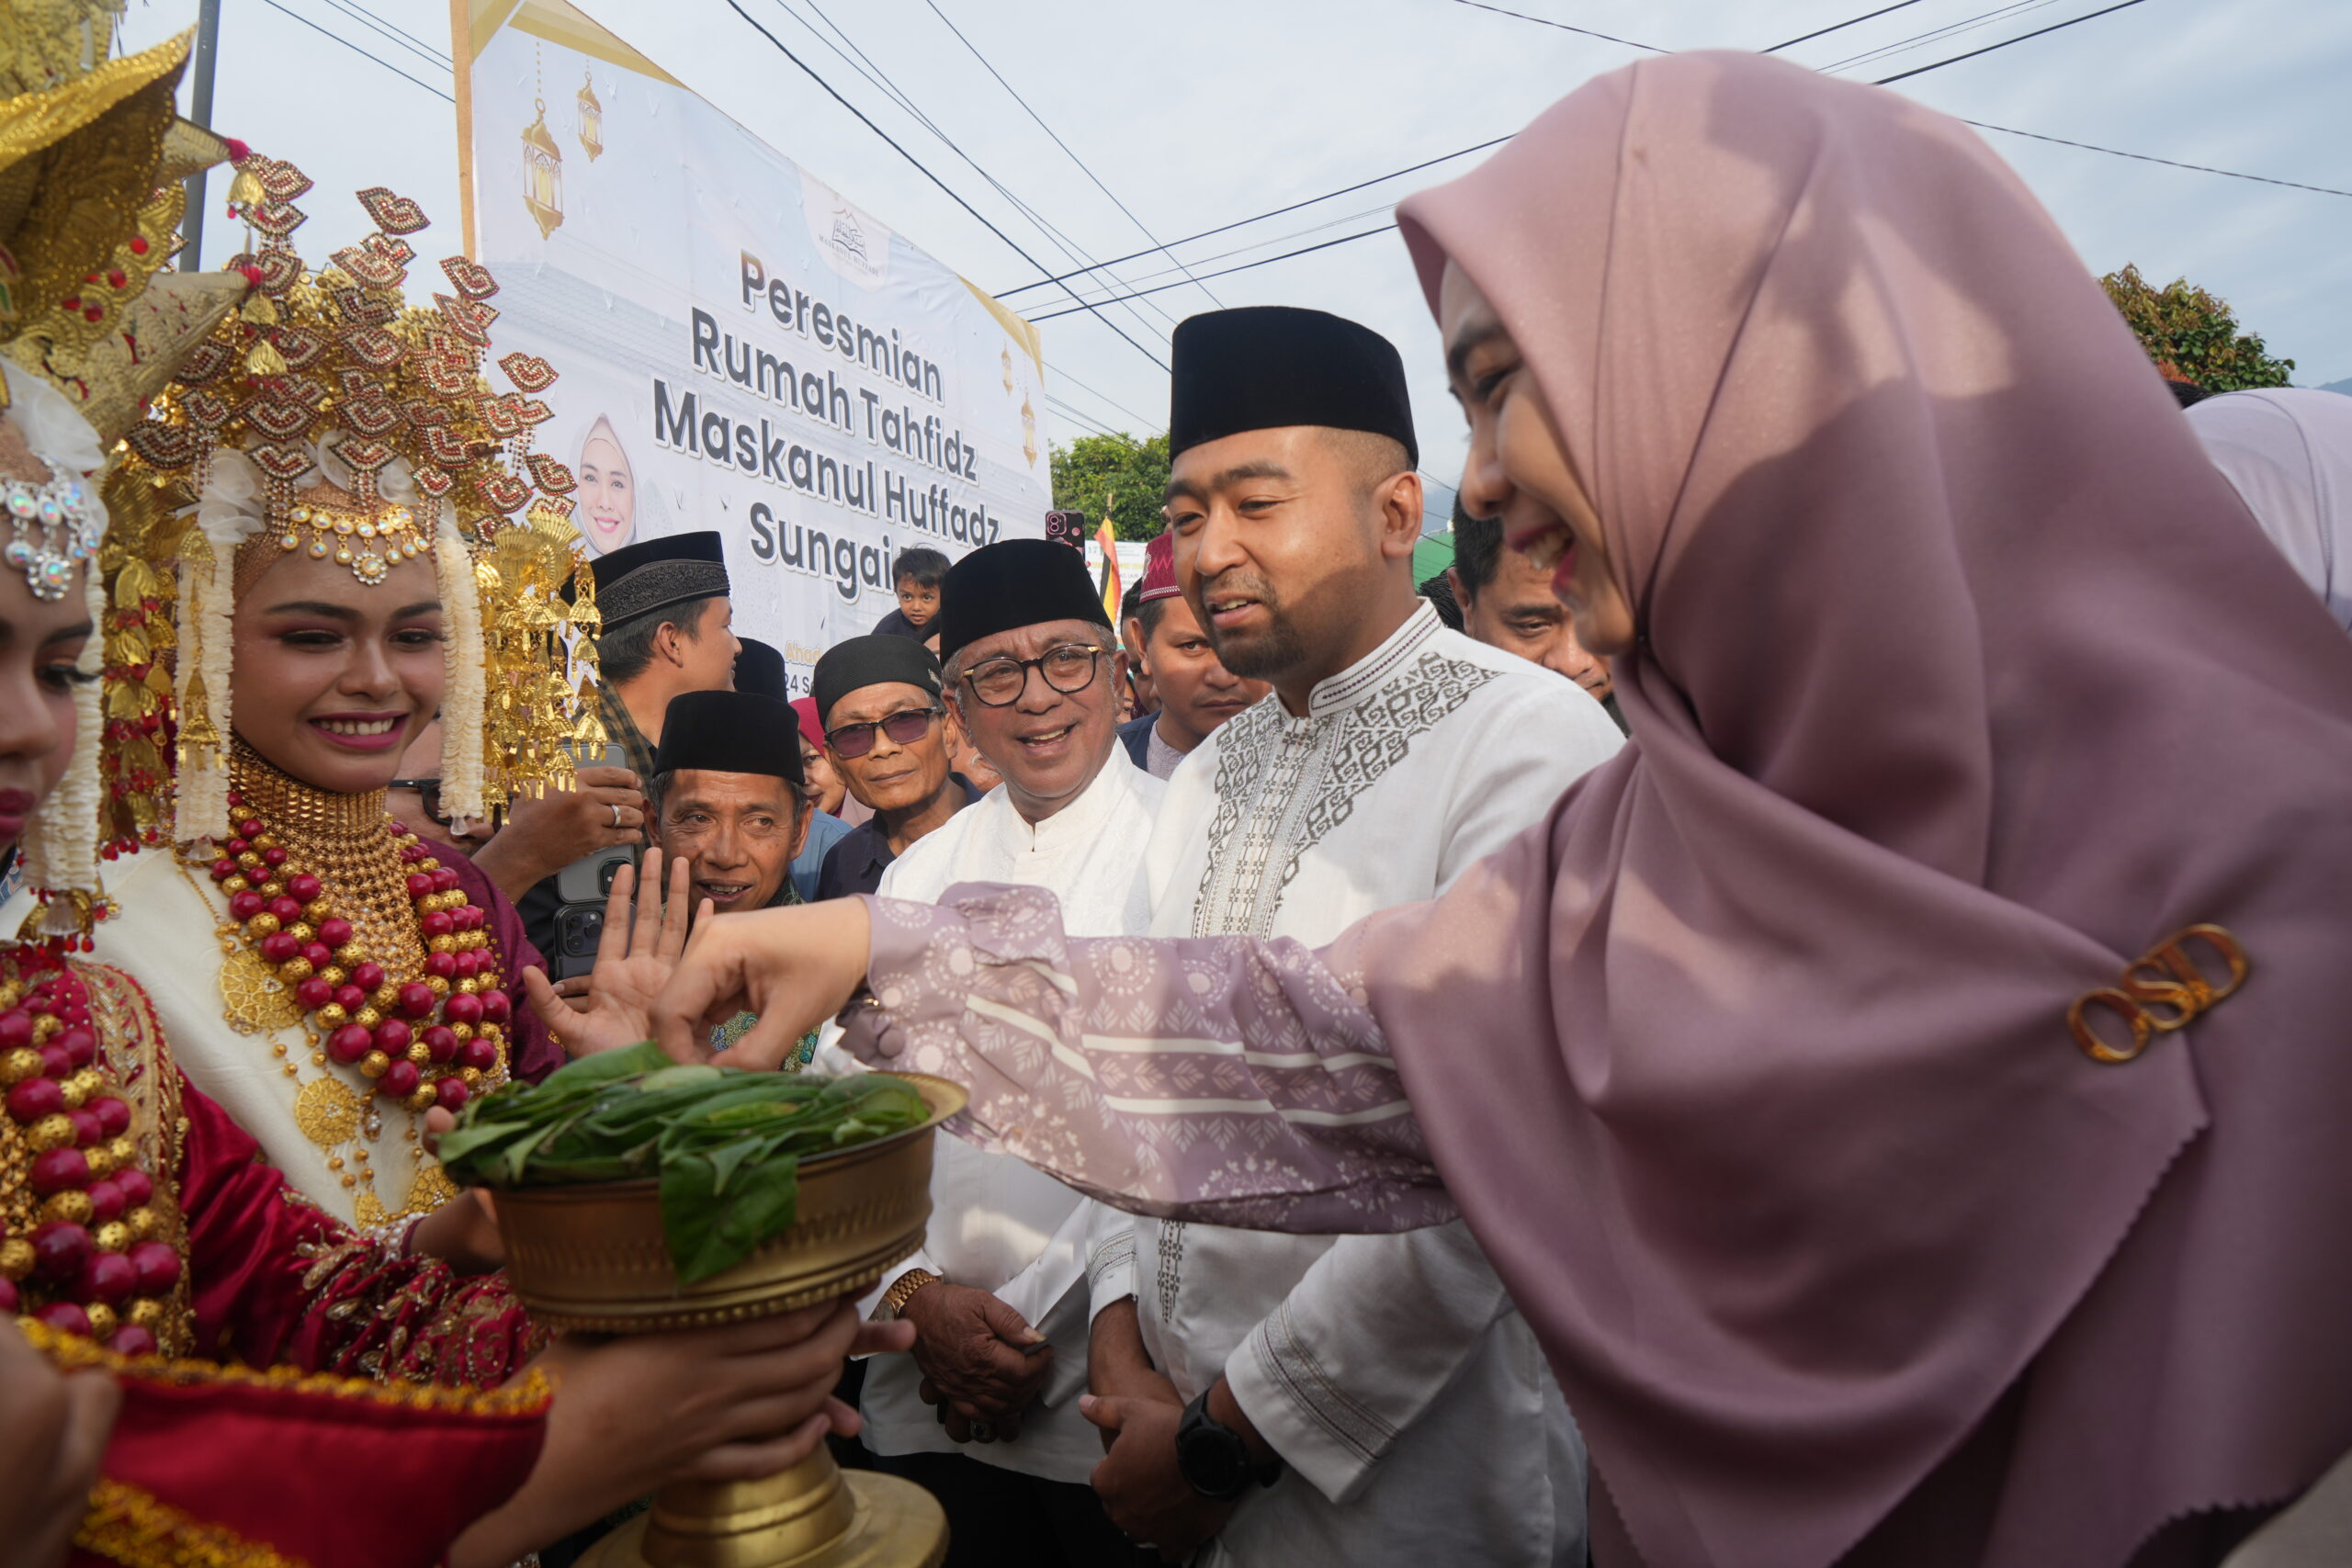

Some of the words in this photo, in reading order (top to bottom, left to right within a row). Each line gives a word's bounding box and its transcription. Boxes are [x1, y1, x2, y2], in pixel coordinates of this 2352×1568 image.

[692, 306, 853, 433] Rumah
[860, 387, 978, 483] Tahfidz
[741, 249, 943, 404] Peresmian
[653, 378, 876, 514] Maskanul
[885, 469, 1000, 547] Huffadz
[750, 502, 893, 600] Sungai
[786, 640, 822, 664] Ahad
